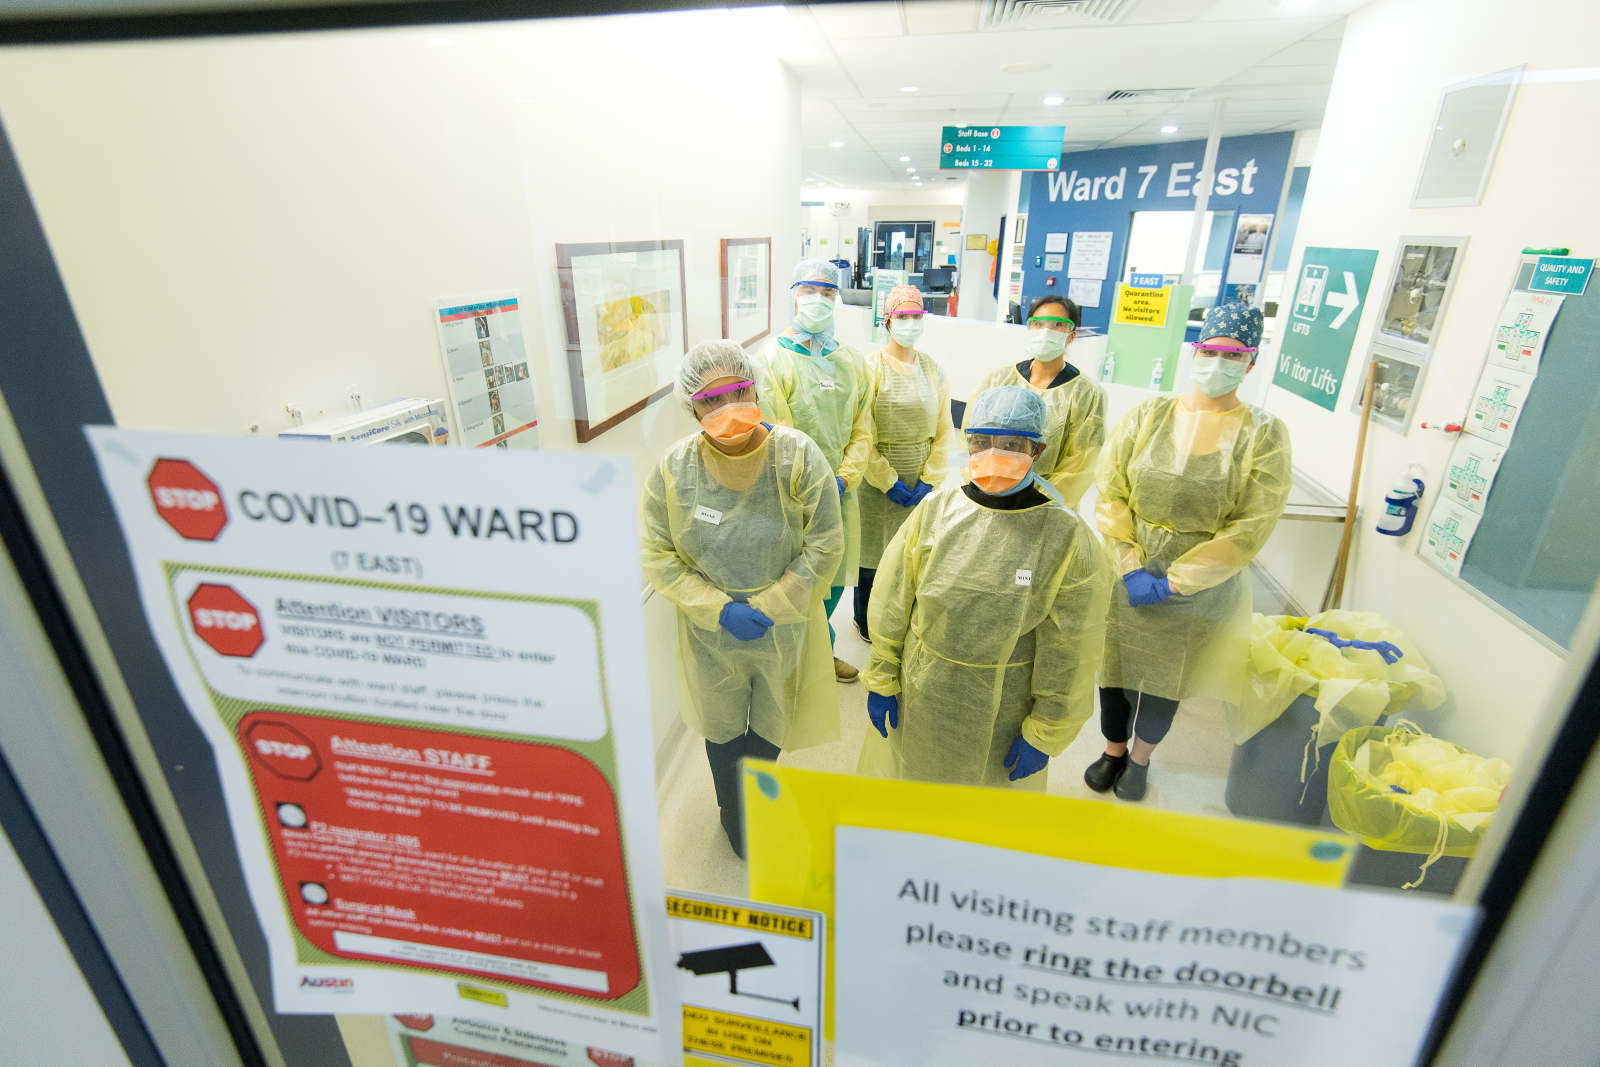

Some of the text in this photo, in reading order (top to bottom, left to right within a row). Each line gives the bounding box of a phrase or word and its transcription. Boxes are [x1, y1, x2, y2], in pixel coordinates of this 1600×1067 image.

[958, 129, 972, 137] Staff
[954, 159, 970, 167] Beds
[1048, 167, 1127, 202] Ward
[1137, 165, 1158, 199] 7
[1134, 276, 1161, 285] 7 EAST
[1540, 263, 1585, 274] QUALITY AND
[1544, 276, 1569, 287] SAFETY
[1124, 290, 1164, 298] Quarantine
[1125, 314, 1155, 322] allowed.
[1133, 306, 1160, 314] visitors
[1292, 322, 1310, 336] LIFTS
[1311, 367, 1338, 395] Lifts
[350, 425, 390, 442] SensiCare
[154, 487, 220, 512] STOP
[441, 505, 580, 546] WARD
[332, 550, 424, 580] (7 EAST)
[194, 597, 486, 635] STOP Attention VISITORS
[281, 624, 345, 642] VISITORS
[376, 633, 404, 648] NOT
[409, 638, 497, 658] PERMITTED
[517, 652, 556, 665] enter
[255, 735, 493, 769] STOP Attention STAFF
[335, 898, 417, 921] Surgical Mask
[667, 900, 807, 934] SECURITY NOTICE
[898, 878, 1368, 971] All visiting staff members
[905, 921, 1343, 1011] please ring the doorbell
[299, 976, 355, 989] Austin
[942, 968, 1280, 1038] and speak with NIC
[713, 1015, 807, 1041] SURVEILLANCE
[957, 1007, 1244, 1067] prior to entering
[687, 1035, 795, 1064] THESE PREMISES
